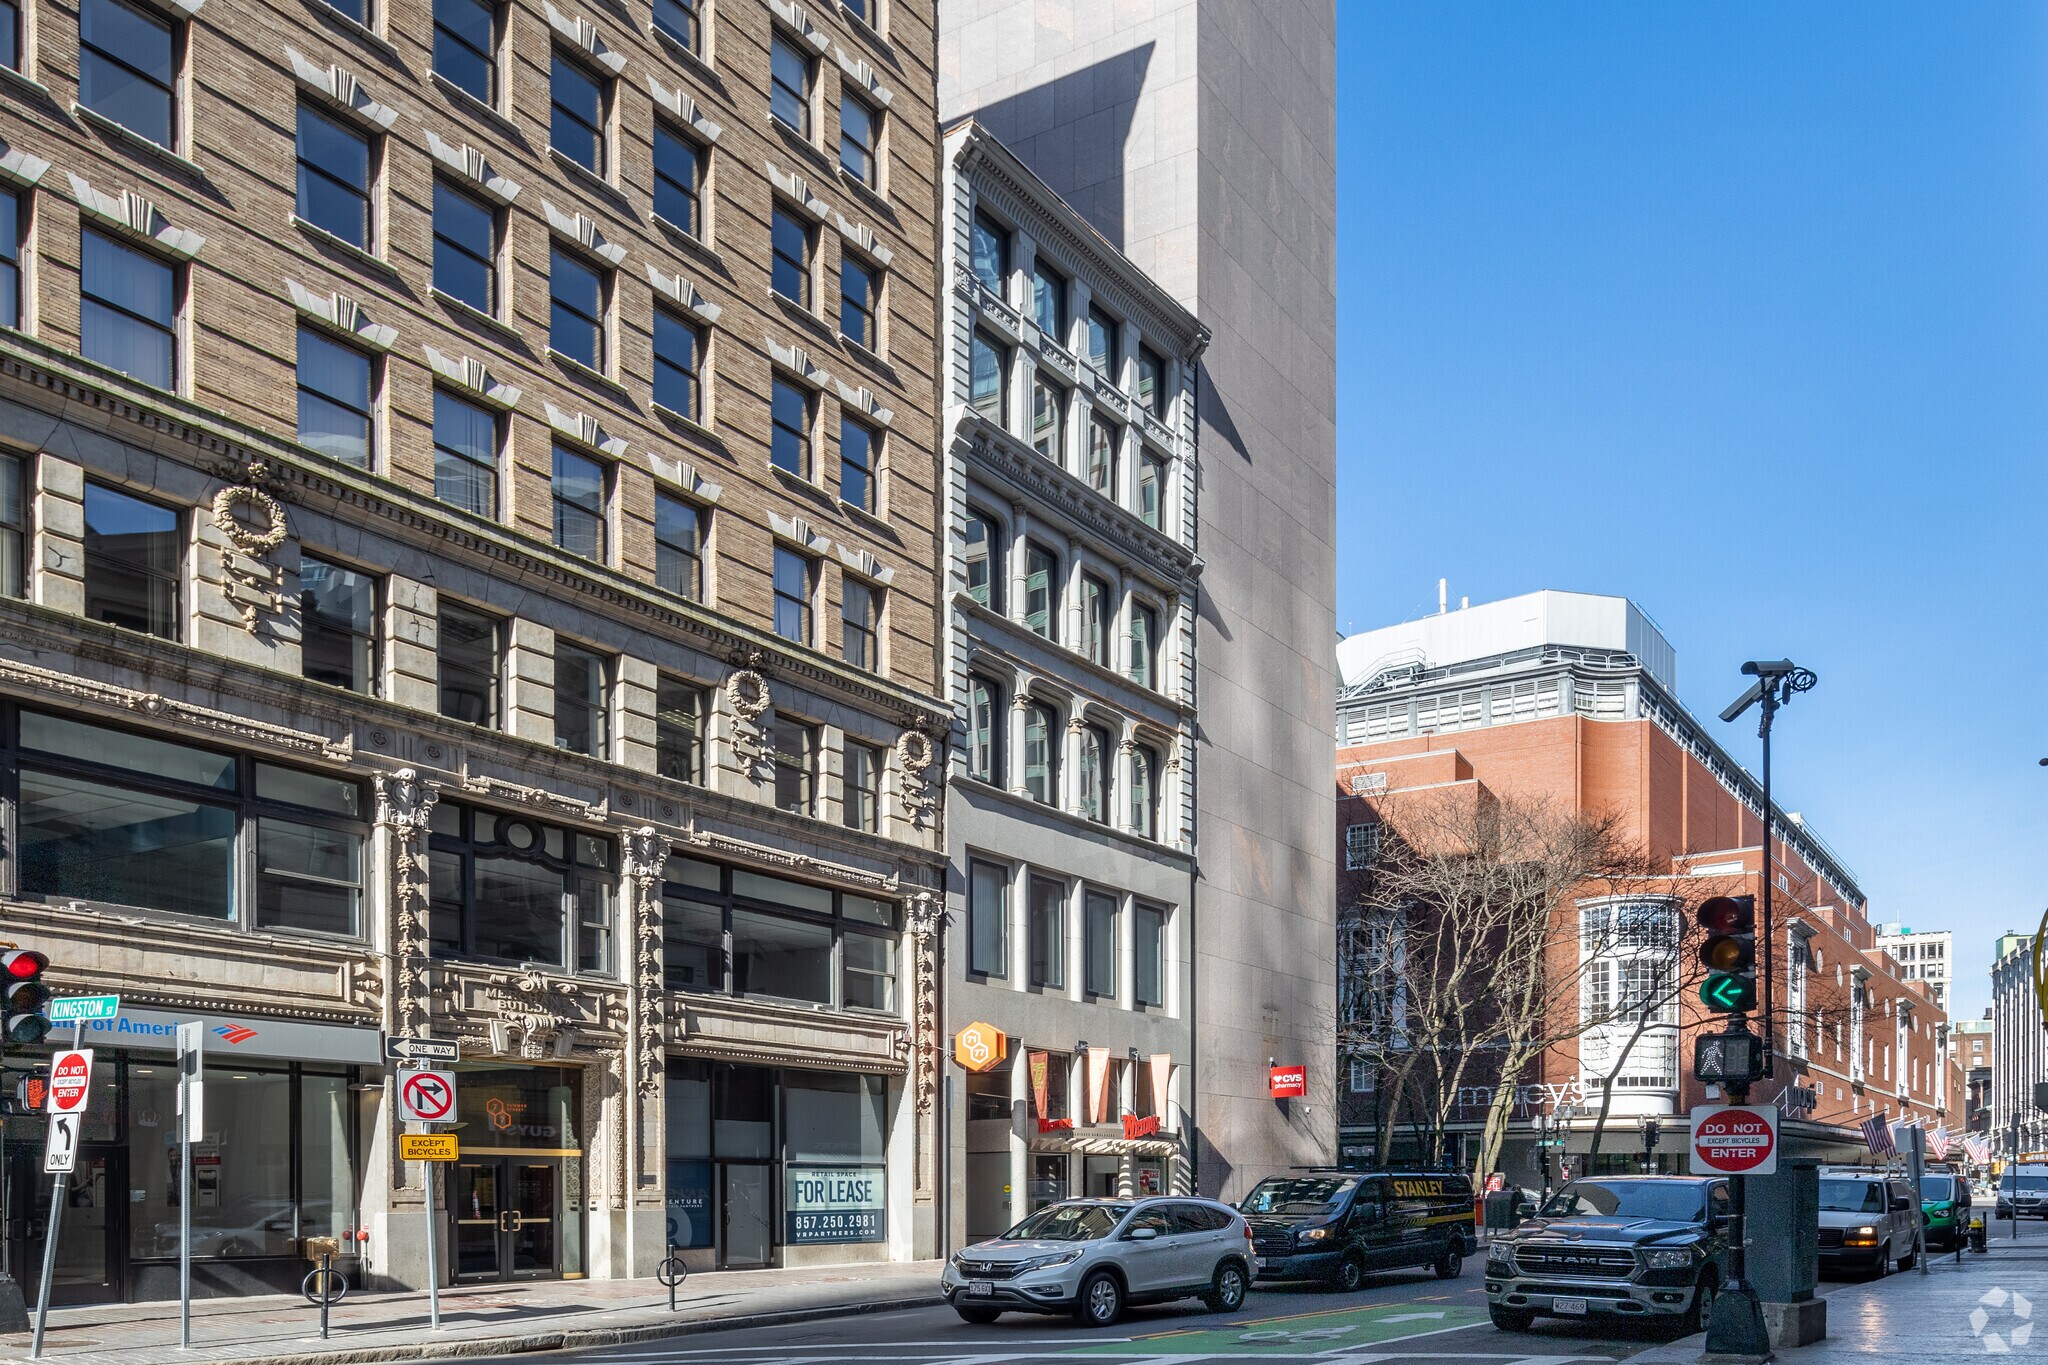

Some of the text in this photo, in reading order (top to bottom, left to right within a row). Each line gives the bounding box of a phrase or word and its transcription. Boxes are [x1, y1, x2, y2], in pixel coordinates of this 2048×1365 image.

[53, 1000, 114, 1017] KINGSTON ST
[117, 1018, 178, 1036] Ameri
[966, 1035, 977, 1044] 71
[409, 1045, 452, 1055] ONE WAY
[973, 1048, 985, 1057] 77
[58, 1065, 85, 1075] DO NOT
[1282, 1074, 1302, 1083] CVS
[58, 1088, 79, 1098] ENTER
[1705, 1123, 1763, 1133] DO NOT
[407, 1148, 451, 1156] BICYCLES
[1711, 1148, 1756, 1158] ENTER
[50, 1154, 70, 1166] ONLY
[795, 1180, 873, 1203] FOR LEASE
[1393, 1180, 1443, 1197] STANLEY
[795, 1214, 875, 1229] 857.250.2981
[796, 1229, 876, 1237] VRPARTNERS.COM
[1547, 1256, 1597, 1265] RAM
